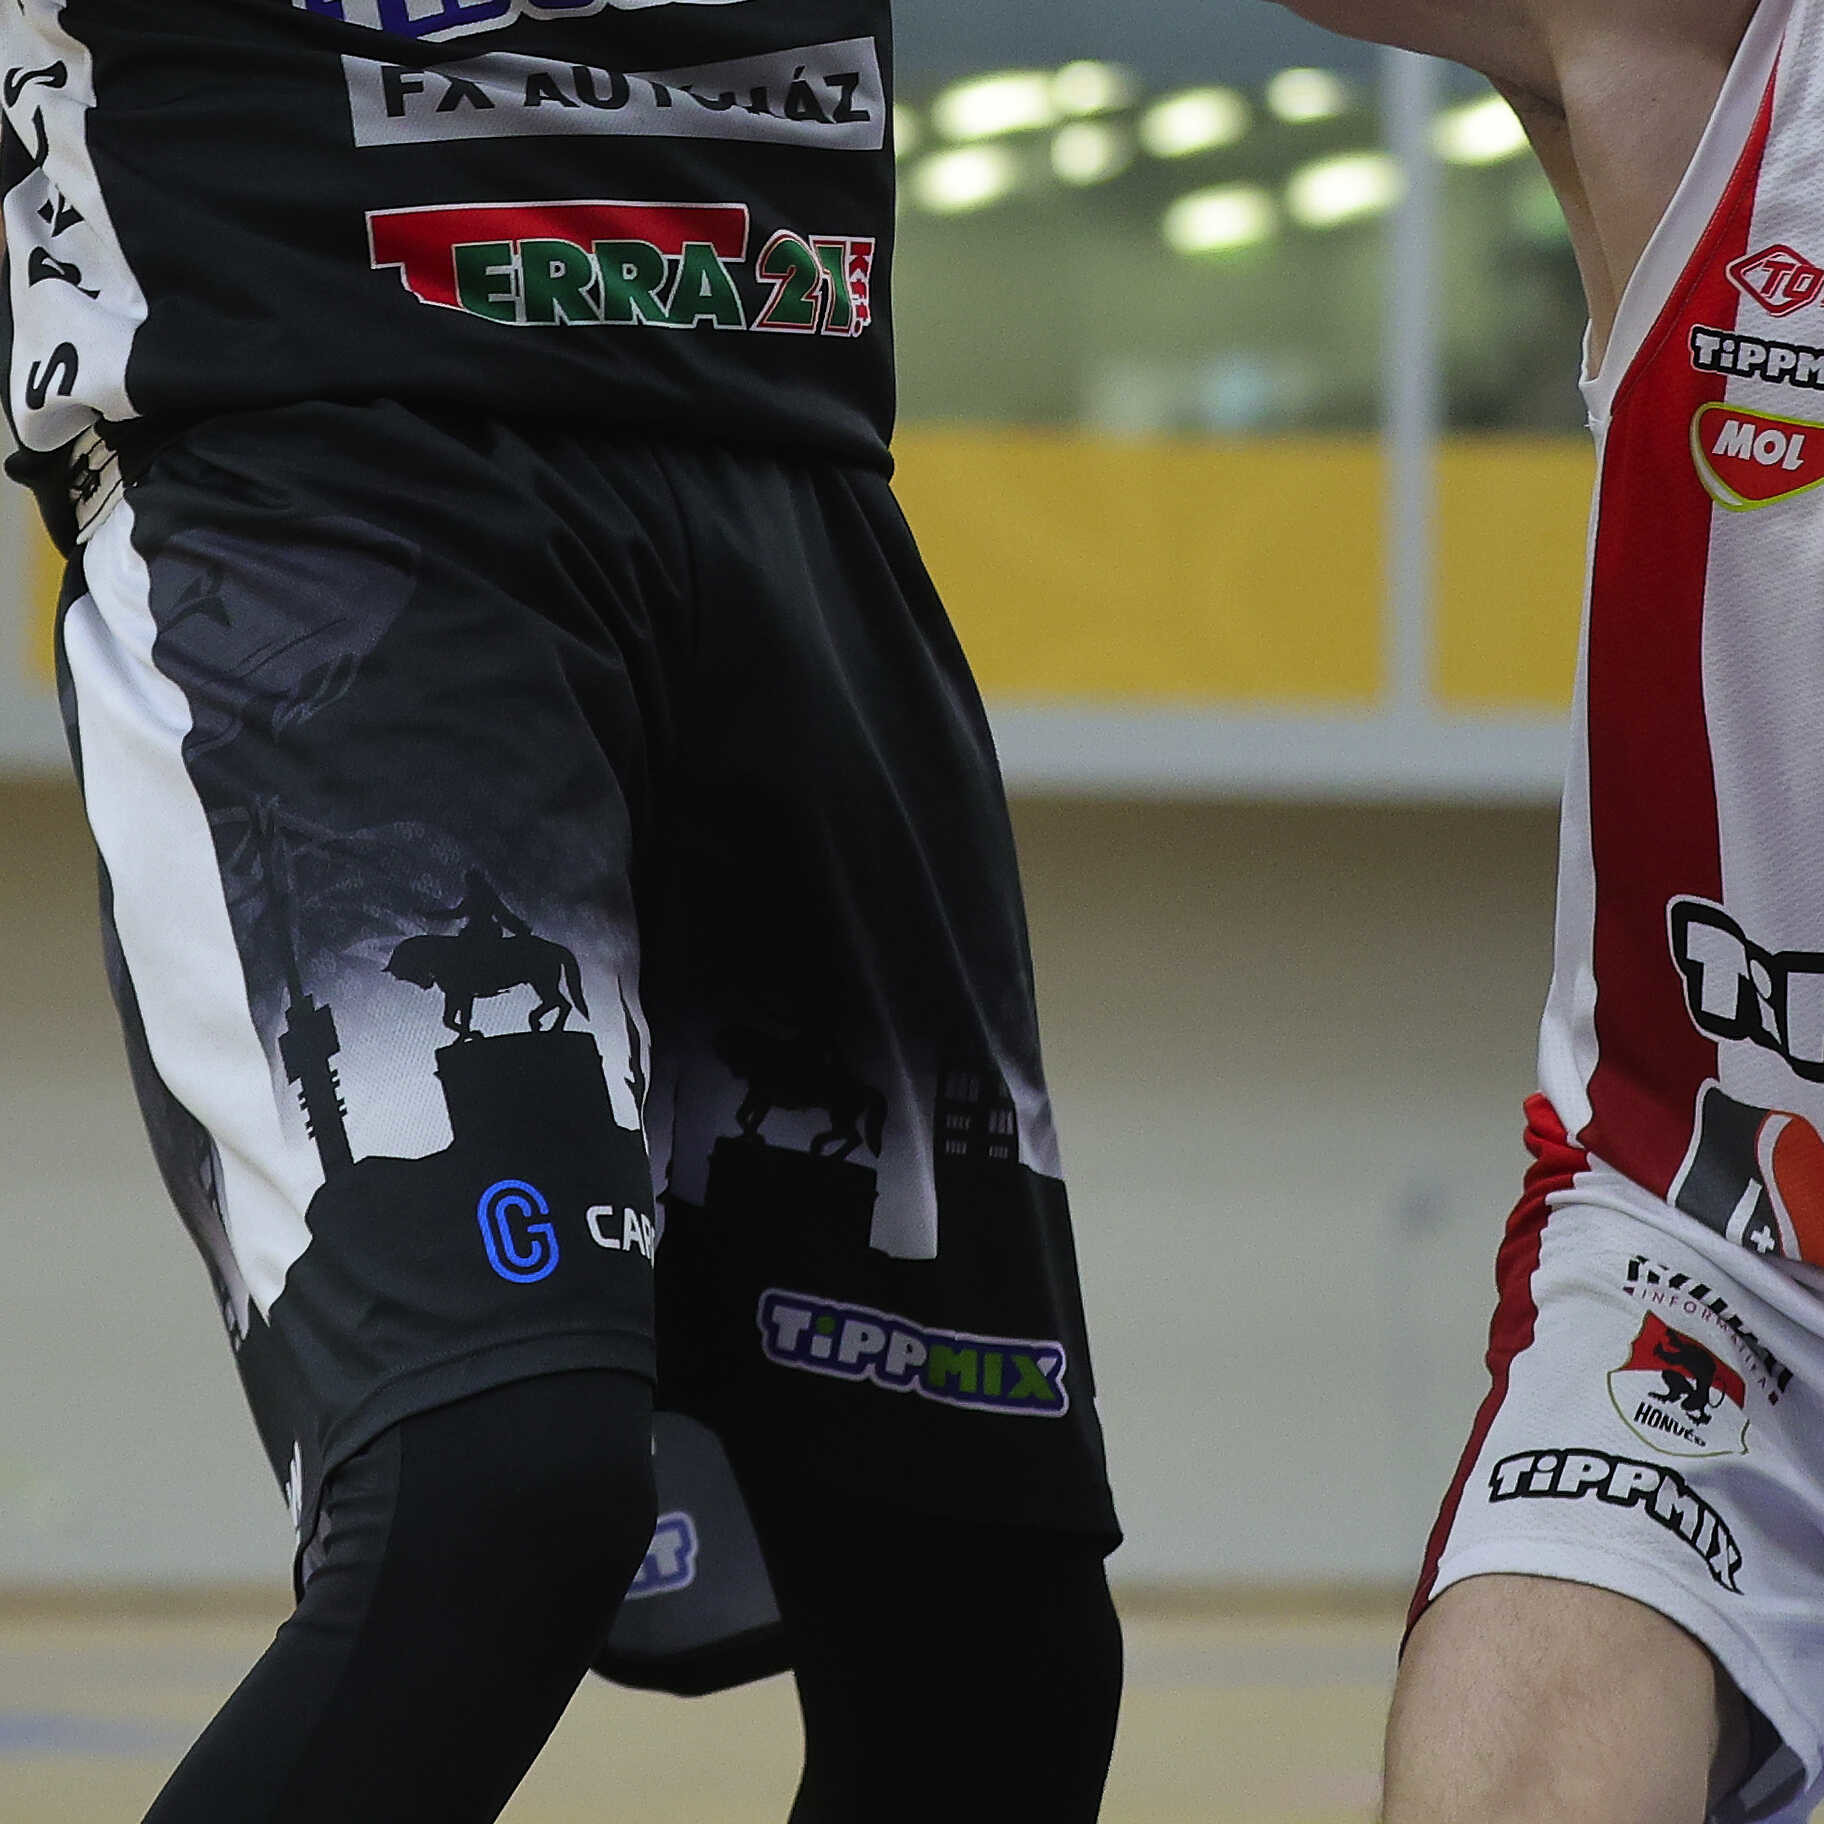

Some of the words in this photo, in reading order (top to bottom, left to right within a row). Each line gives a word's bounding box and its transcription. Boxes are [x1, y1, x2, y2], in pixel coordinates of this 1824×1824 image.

[381, 65, 496, 118] FX
[366, 202, 750, 330] TERRA
[1711, 419, 1805, 471] MOL
